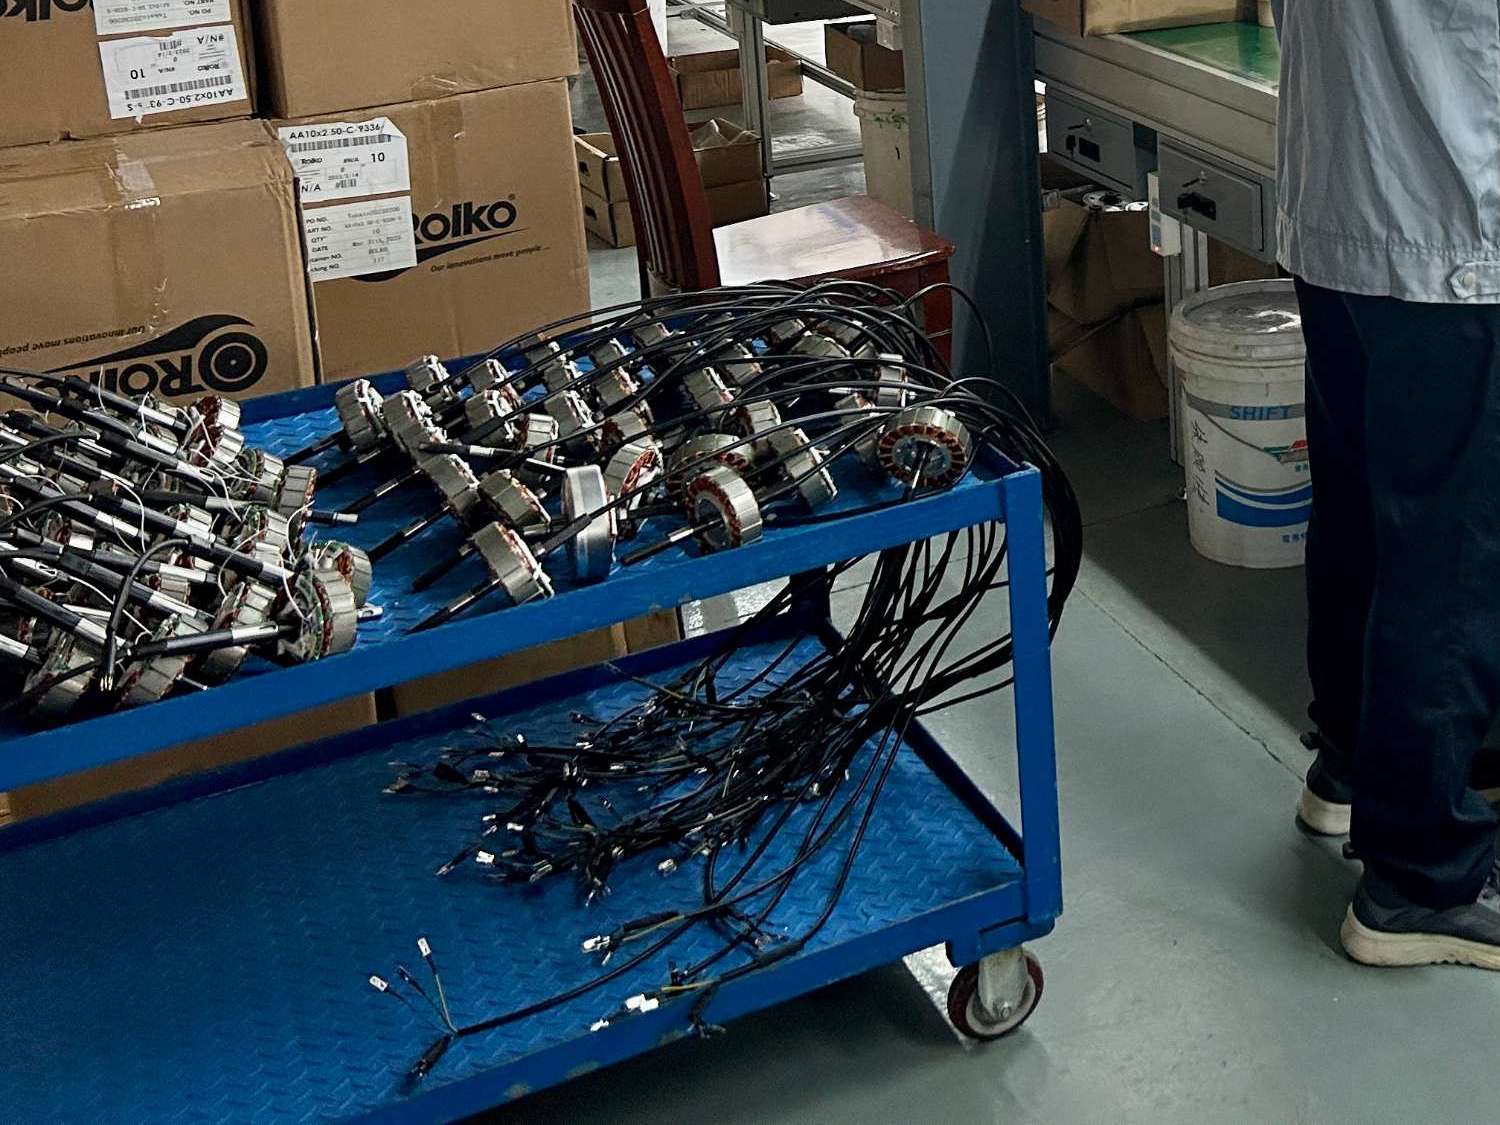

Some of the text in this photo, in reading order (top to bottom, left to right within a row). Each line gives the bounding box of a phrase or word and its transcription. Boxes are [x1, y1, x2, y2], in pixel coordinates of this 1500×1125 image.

[130, 68, 146, 80] 10
[371, 152, 385, 163] 10
[312, 245, 328, 253] DATE
[430, 264, 445, 273] Our
[446, 255, 492, 270] innovations
[493, 250, 515, 261] move
[32, 339, 61, 352] move
[1229, 405, 1292, 421] SHIFT
